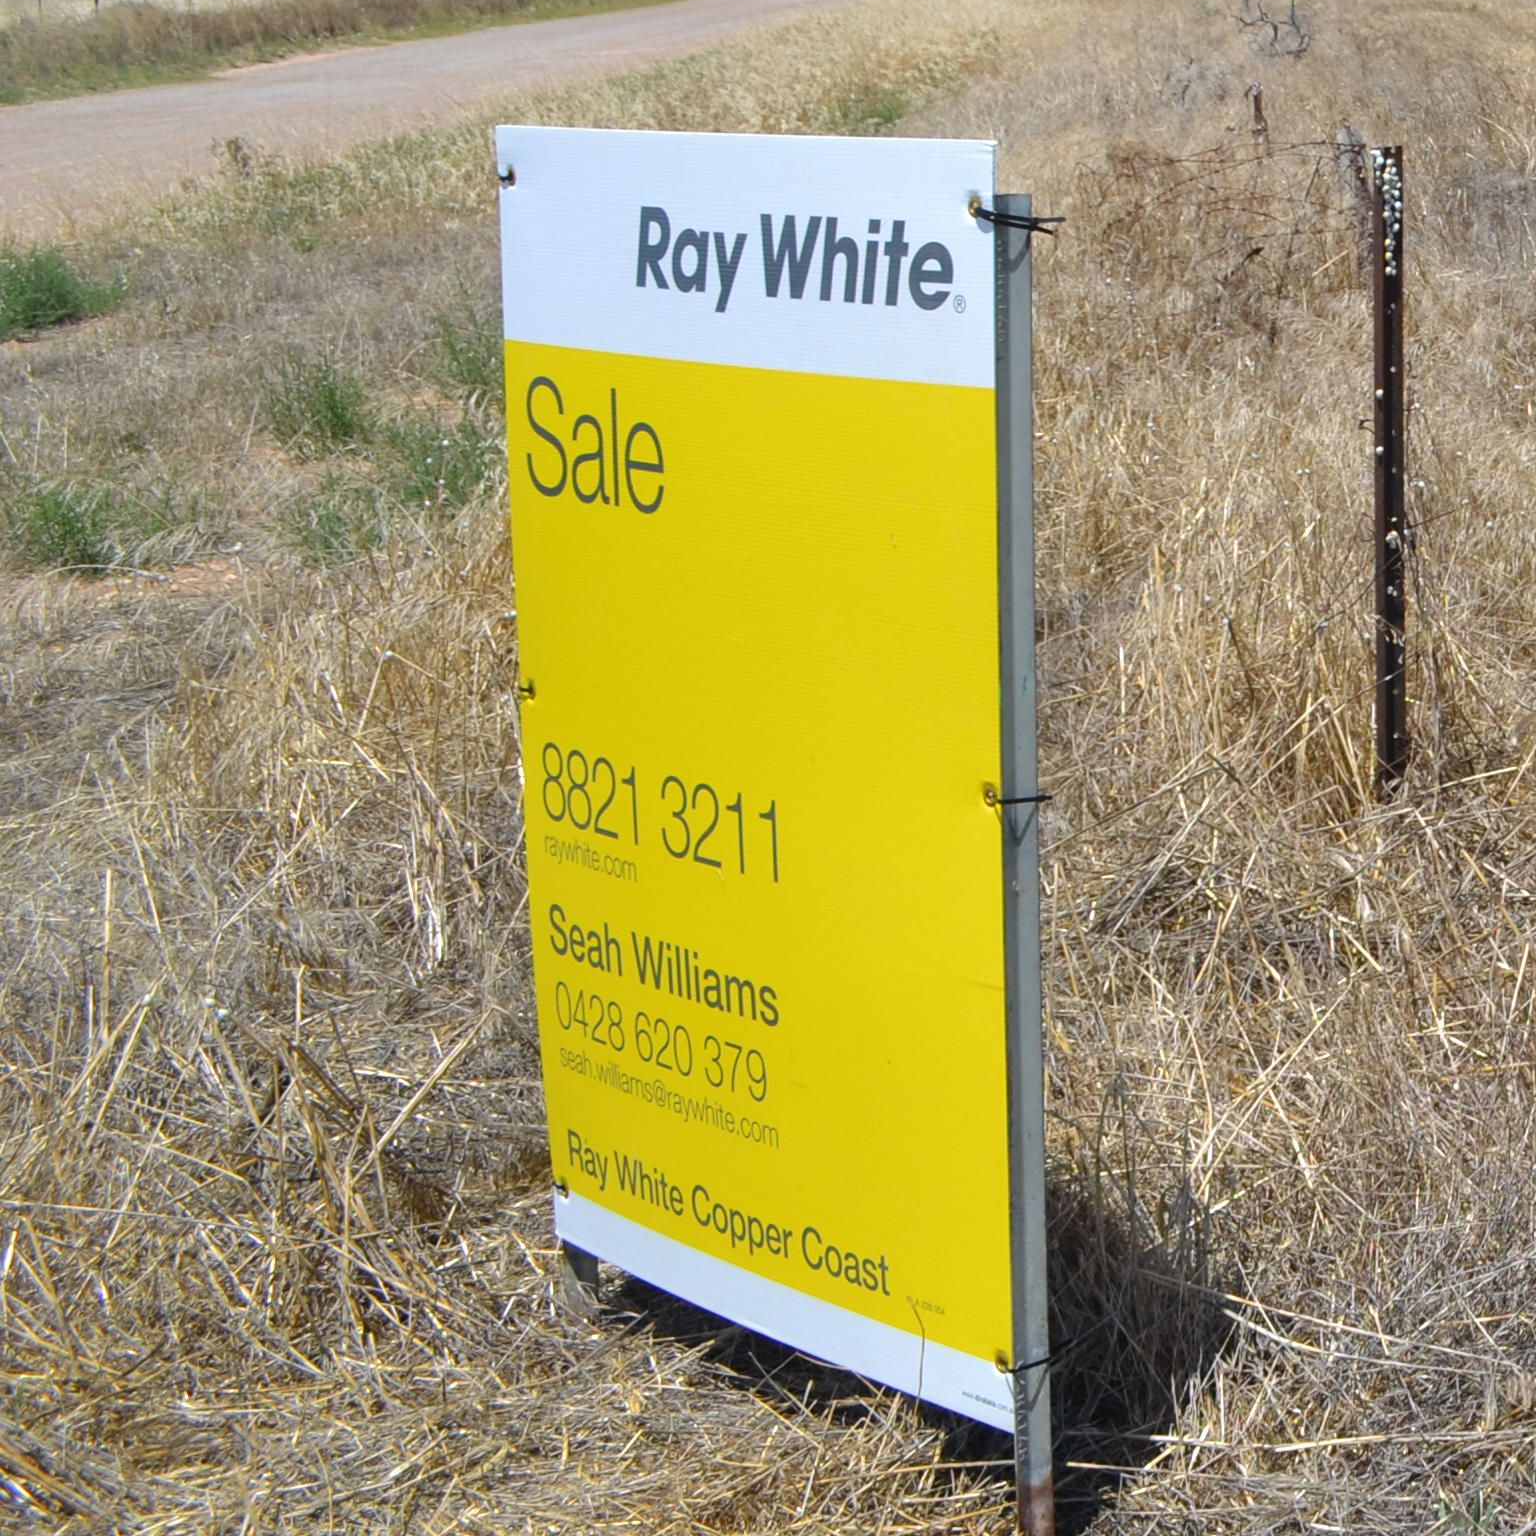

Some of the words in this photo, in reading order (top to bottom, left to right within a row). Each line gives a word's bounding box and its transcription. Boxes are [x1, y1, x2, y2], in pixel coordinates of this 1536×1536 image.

[636, 206, 748, 313] Ray
[760, 213, 954, 311] White
[526, 376, 665, 515] Sale
[542, 742, 639, 845] 8821
[661, 775, 778, 883] 3211
[544, 832, 637, 883] raywhite.com
[549, 903, 623, 977] Seah
[631, 931, 780, 1026] Williams
[555, 980, 625, 1053] 0428
[634, 1011, 693, 1077] 620
[704, 1035, 767, 1102] 379
[560, 1045, 780, 1149] seah.williams@raywhite.com
[568, 1128, 608, 1192] Ray
[614, 1150, 684, 1216] White
[691, 1185, 792, 1257] Copper
[801, 1226, 890, 1296] Coast
